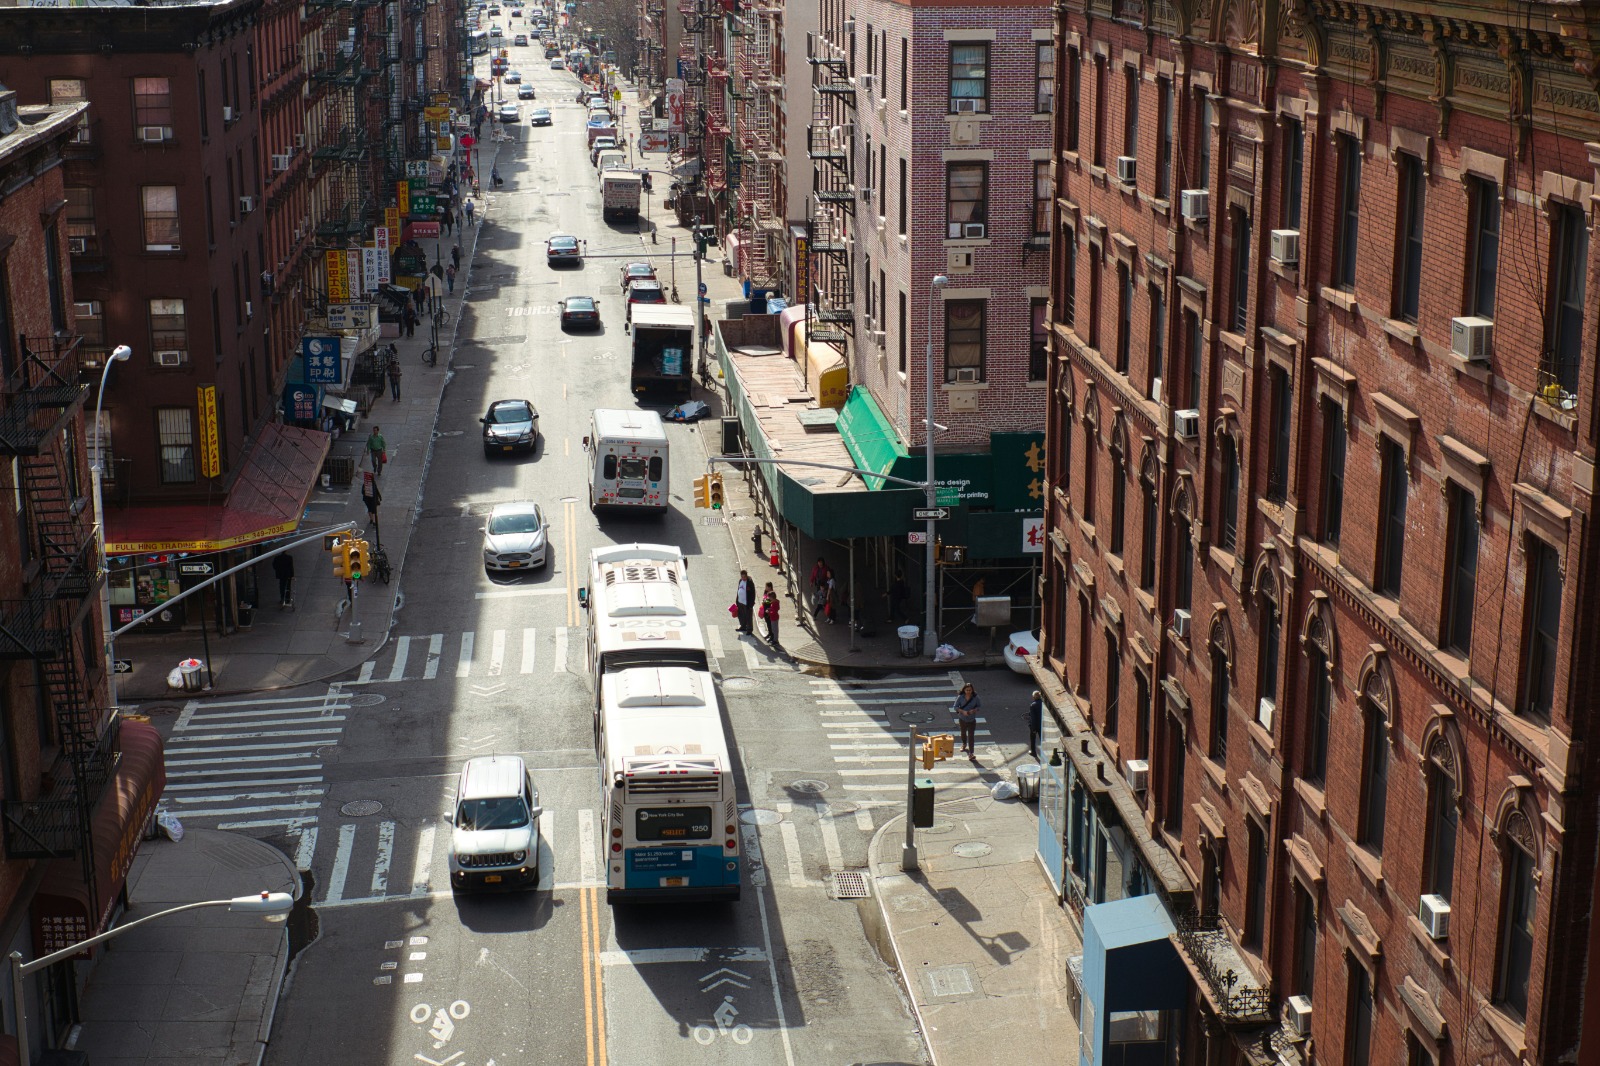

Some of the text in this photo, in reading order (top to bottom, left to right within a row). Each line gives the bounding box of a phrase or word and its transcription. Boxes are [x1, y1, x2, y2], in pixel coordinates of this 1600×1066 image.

[504, 305, 559, 317] SCHOOL
[946, 478, 971, 486] design
[966, 491, 989, 499] printing
[251, 525, 284, 539] 349-7036
[115, 543, 135, 551] FULL
[138, 542, 158, 550] HING
[160, 541, 197, 550] TRADING
[618, 619, 687, 628] 1250
